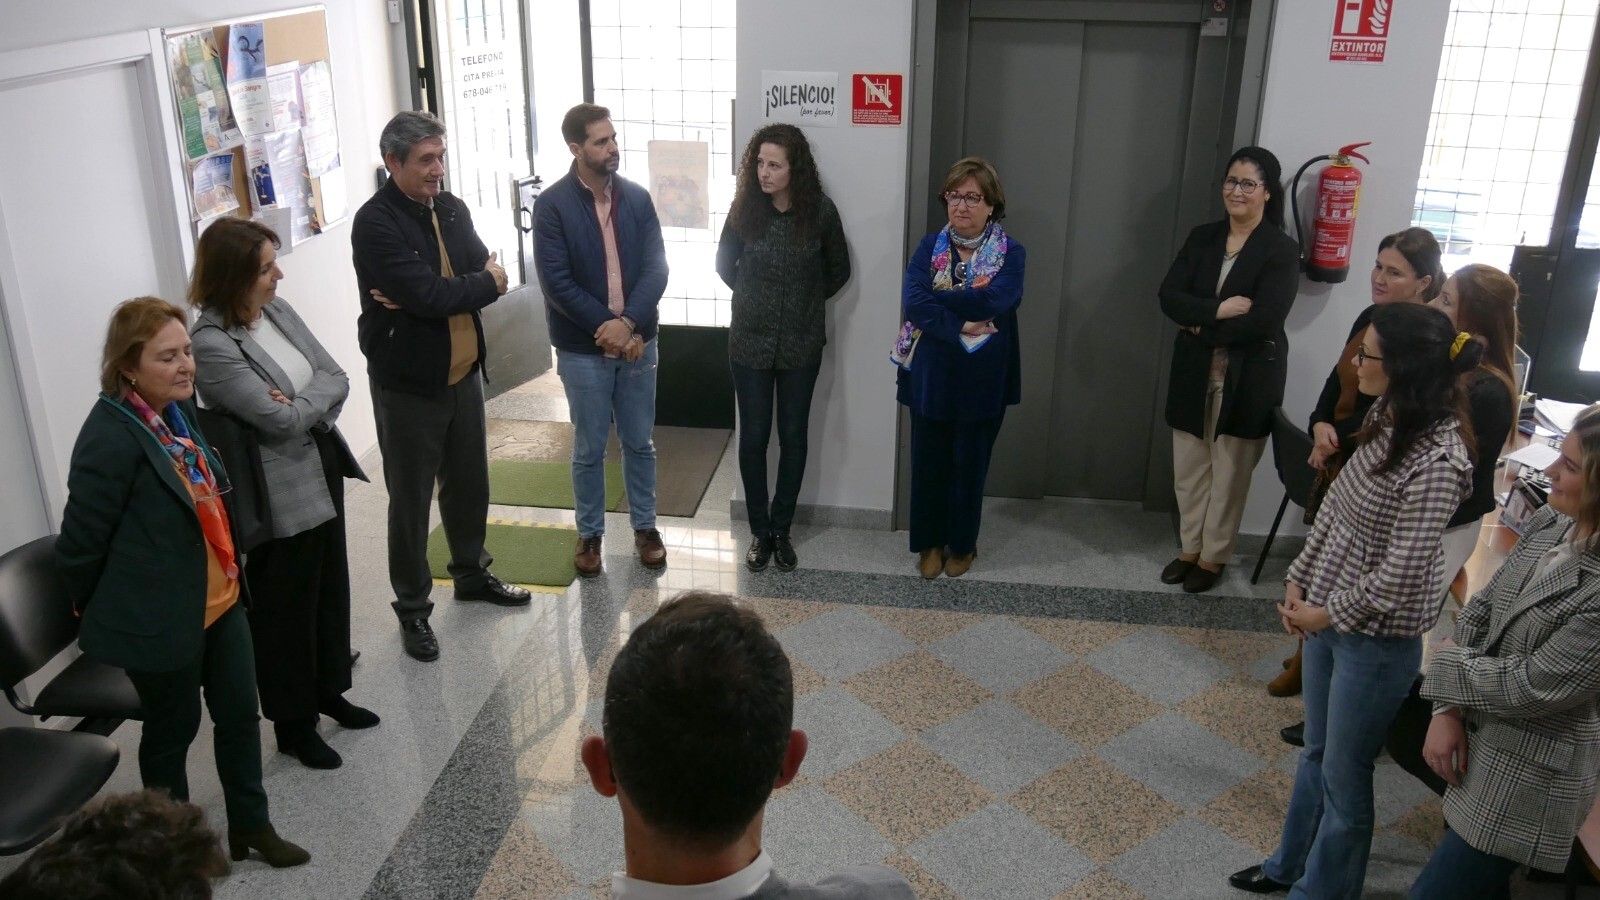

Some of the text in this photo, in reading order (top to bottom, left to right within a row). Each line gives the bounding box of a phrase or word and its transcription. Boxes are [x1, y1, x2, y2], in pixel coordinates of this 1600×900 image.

[1331, 41, 1384, 53] EXTINTOR
[461, 51, 503, 66] TELEFONO
[463, 69, 504, 82] CITA PREIA
[766, 83, 835, 118] ¡SILENCIO!
